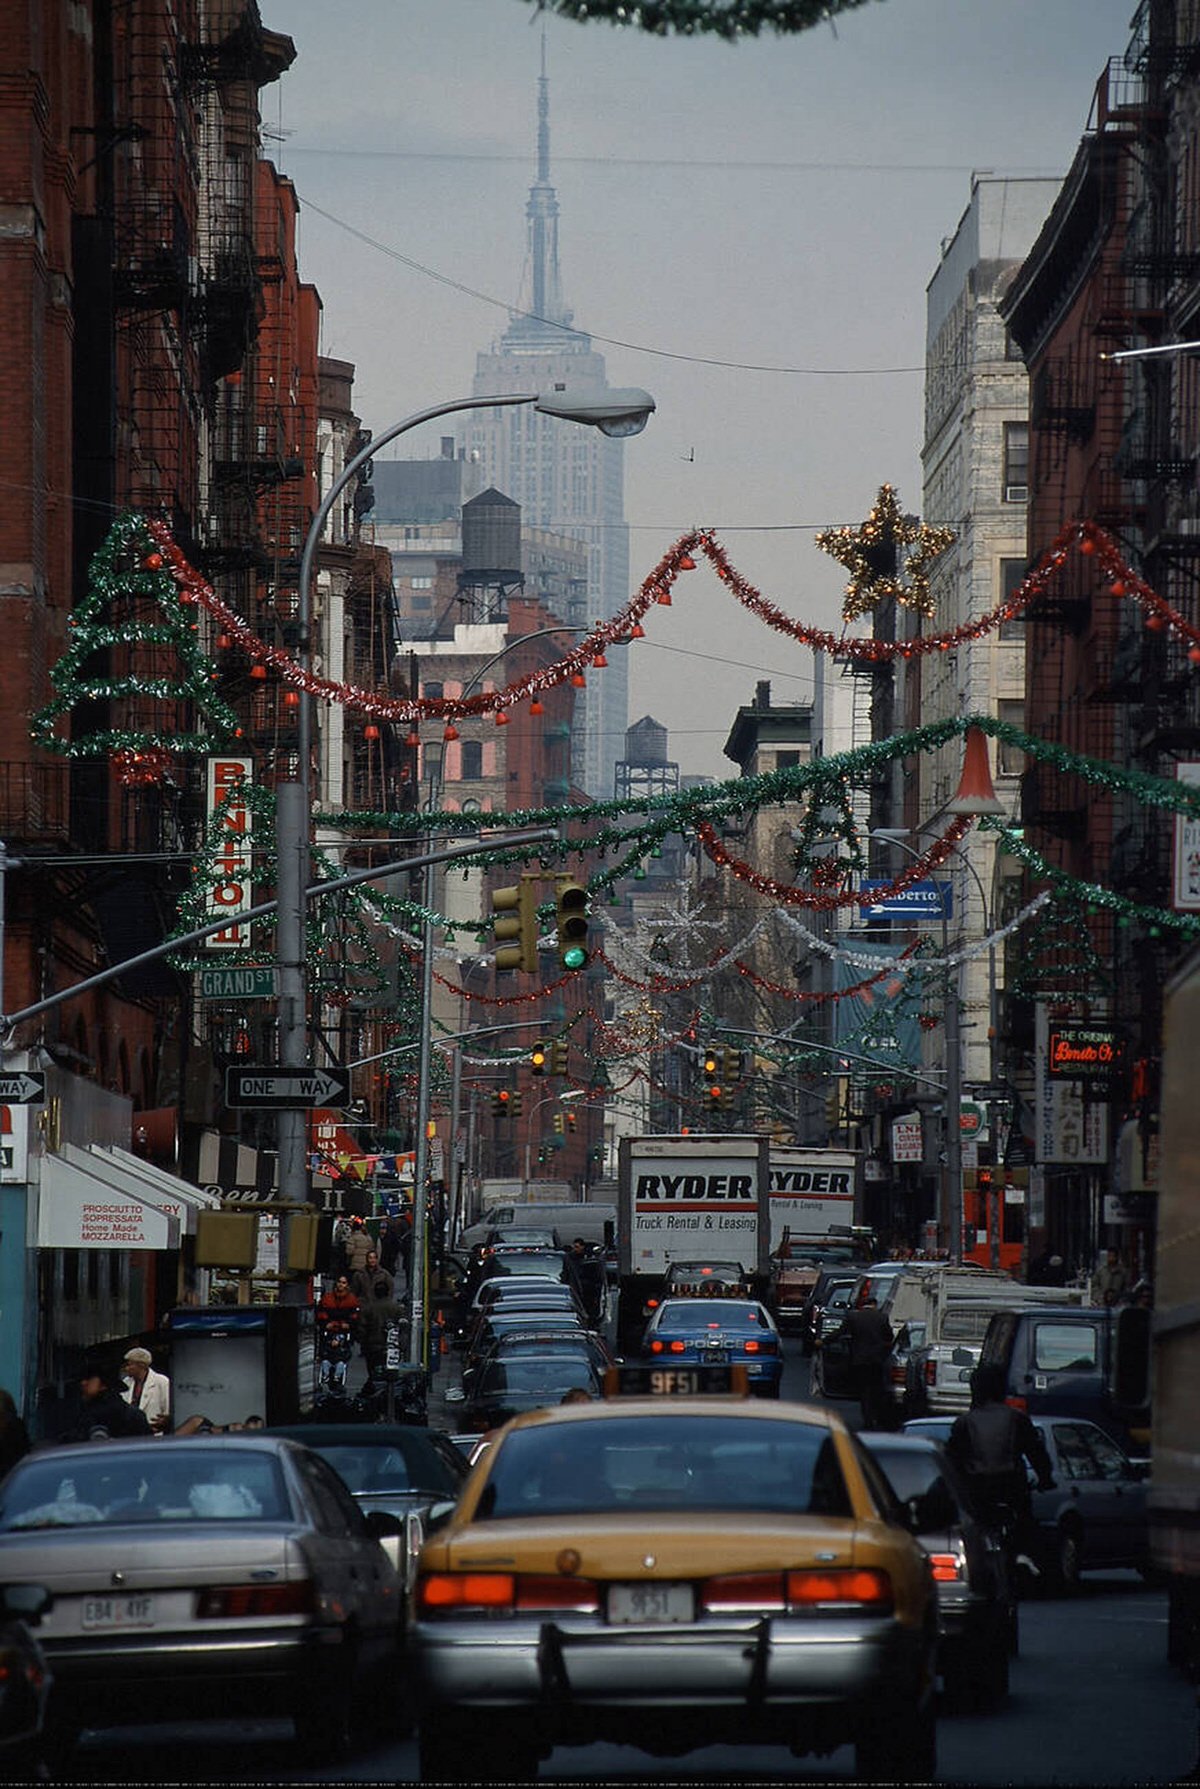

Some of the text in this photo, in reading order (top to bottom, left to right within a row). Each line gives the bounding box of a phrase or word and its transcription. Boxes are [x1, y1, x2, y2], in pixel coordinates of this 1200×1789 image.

[1184, 826, 1200, 847] RI
[203, 971, 272, 996] GRAND ST
[1059, 1030, 1077, 1041] THE
[0, 1081, 28, 1094] WAY
[242, 1080, 333, 1095] ONE WAY
[636, 1175, 753, 1199] RYDER
[321, 1189, 346, 1211] II
[83, 1204, 143, 1214] PROSCIUTTO
[157, 1204, 180, 1215] RY
[83, 1214, 143, 1223] SOPRESSATA
[636, 1215, 757, 1232] Truck Rental & Leasing
[82, 1224, 138, 1232] Home Made
[82, 1233, 145, 1241] MOZZARELLA
[684, 1339, 745, 1349] POLICE
